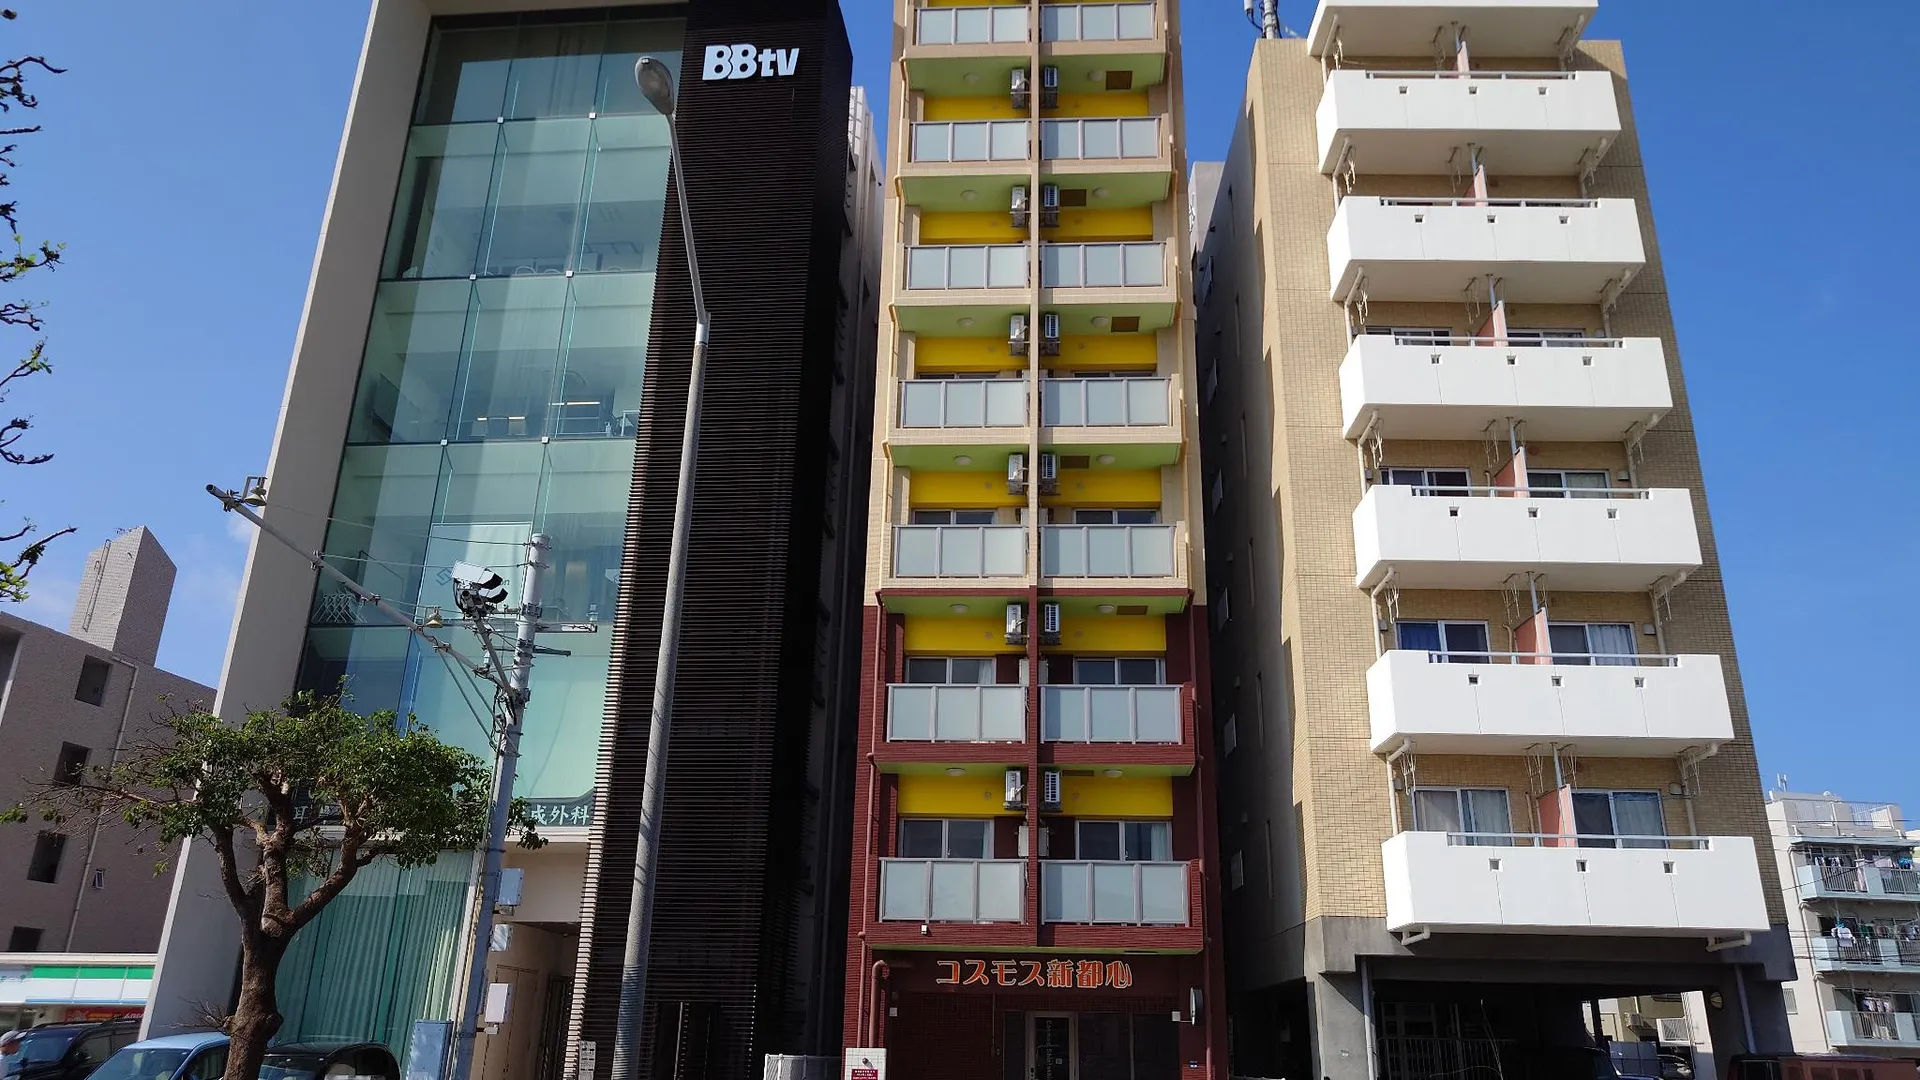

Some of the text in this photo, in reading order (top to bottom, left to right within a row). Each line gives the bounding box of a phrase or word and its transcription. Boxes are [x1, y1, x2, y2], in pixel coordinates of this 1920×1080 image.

[702, 43, 800, 81] BBtv
[521, 804, 590, 826] 成外科
[936, 959, 1133, 989] コスモス新都心
